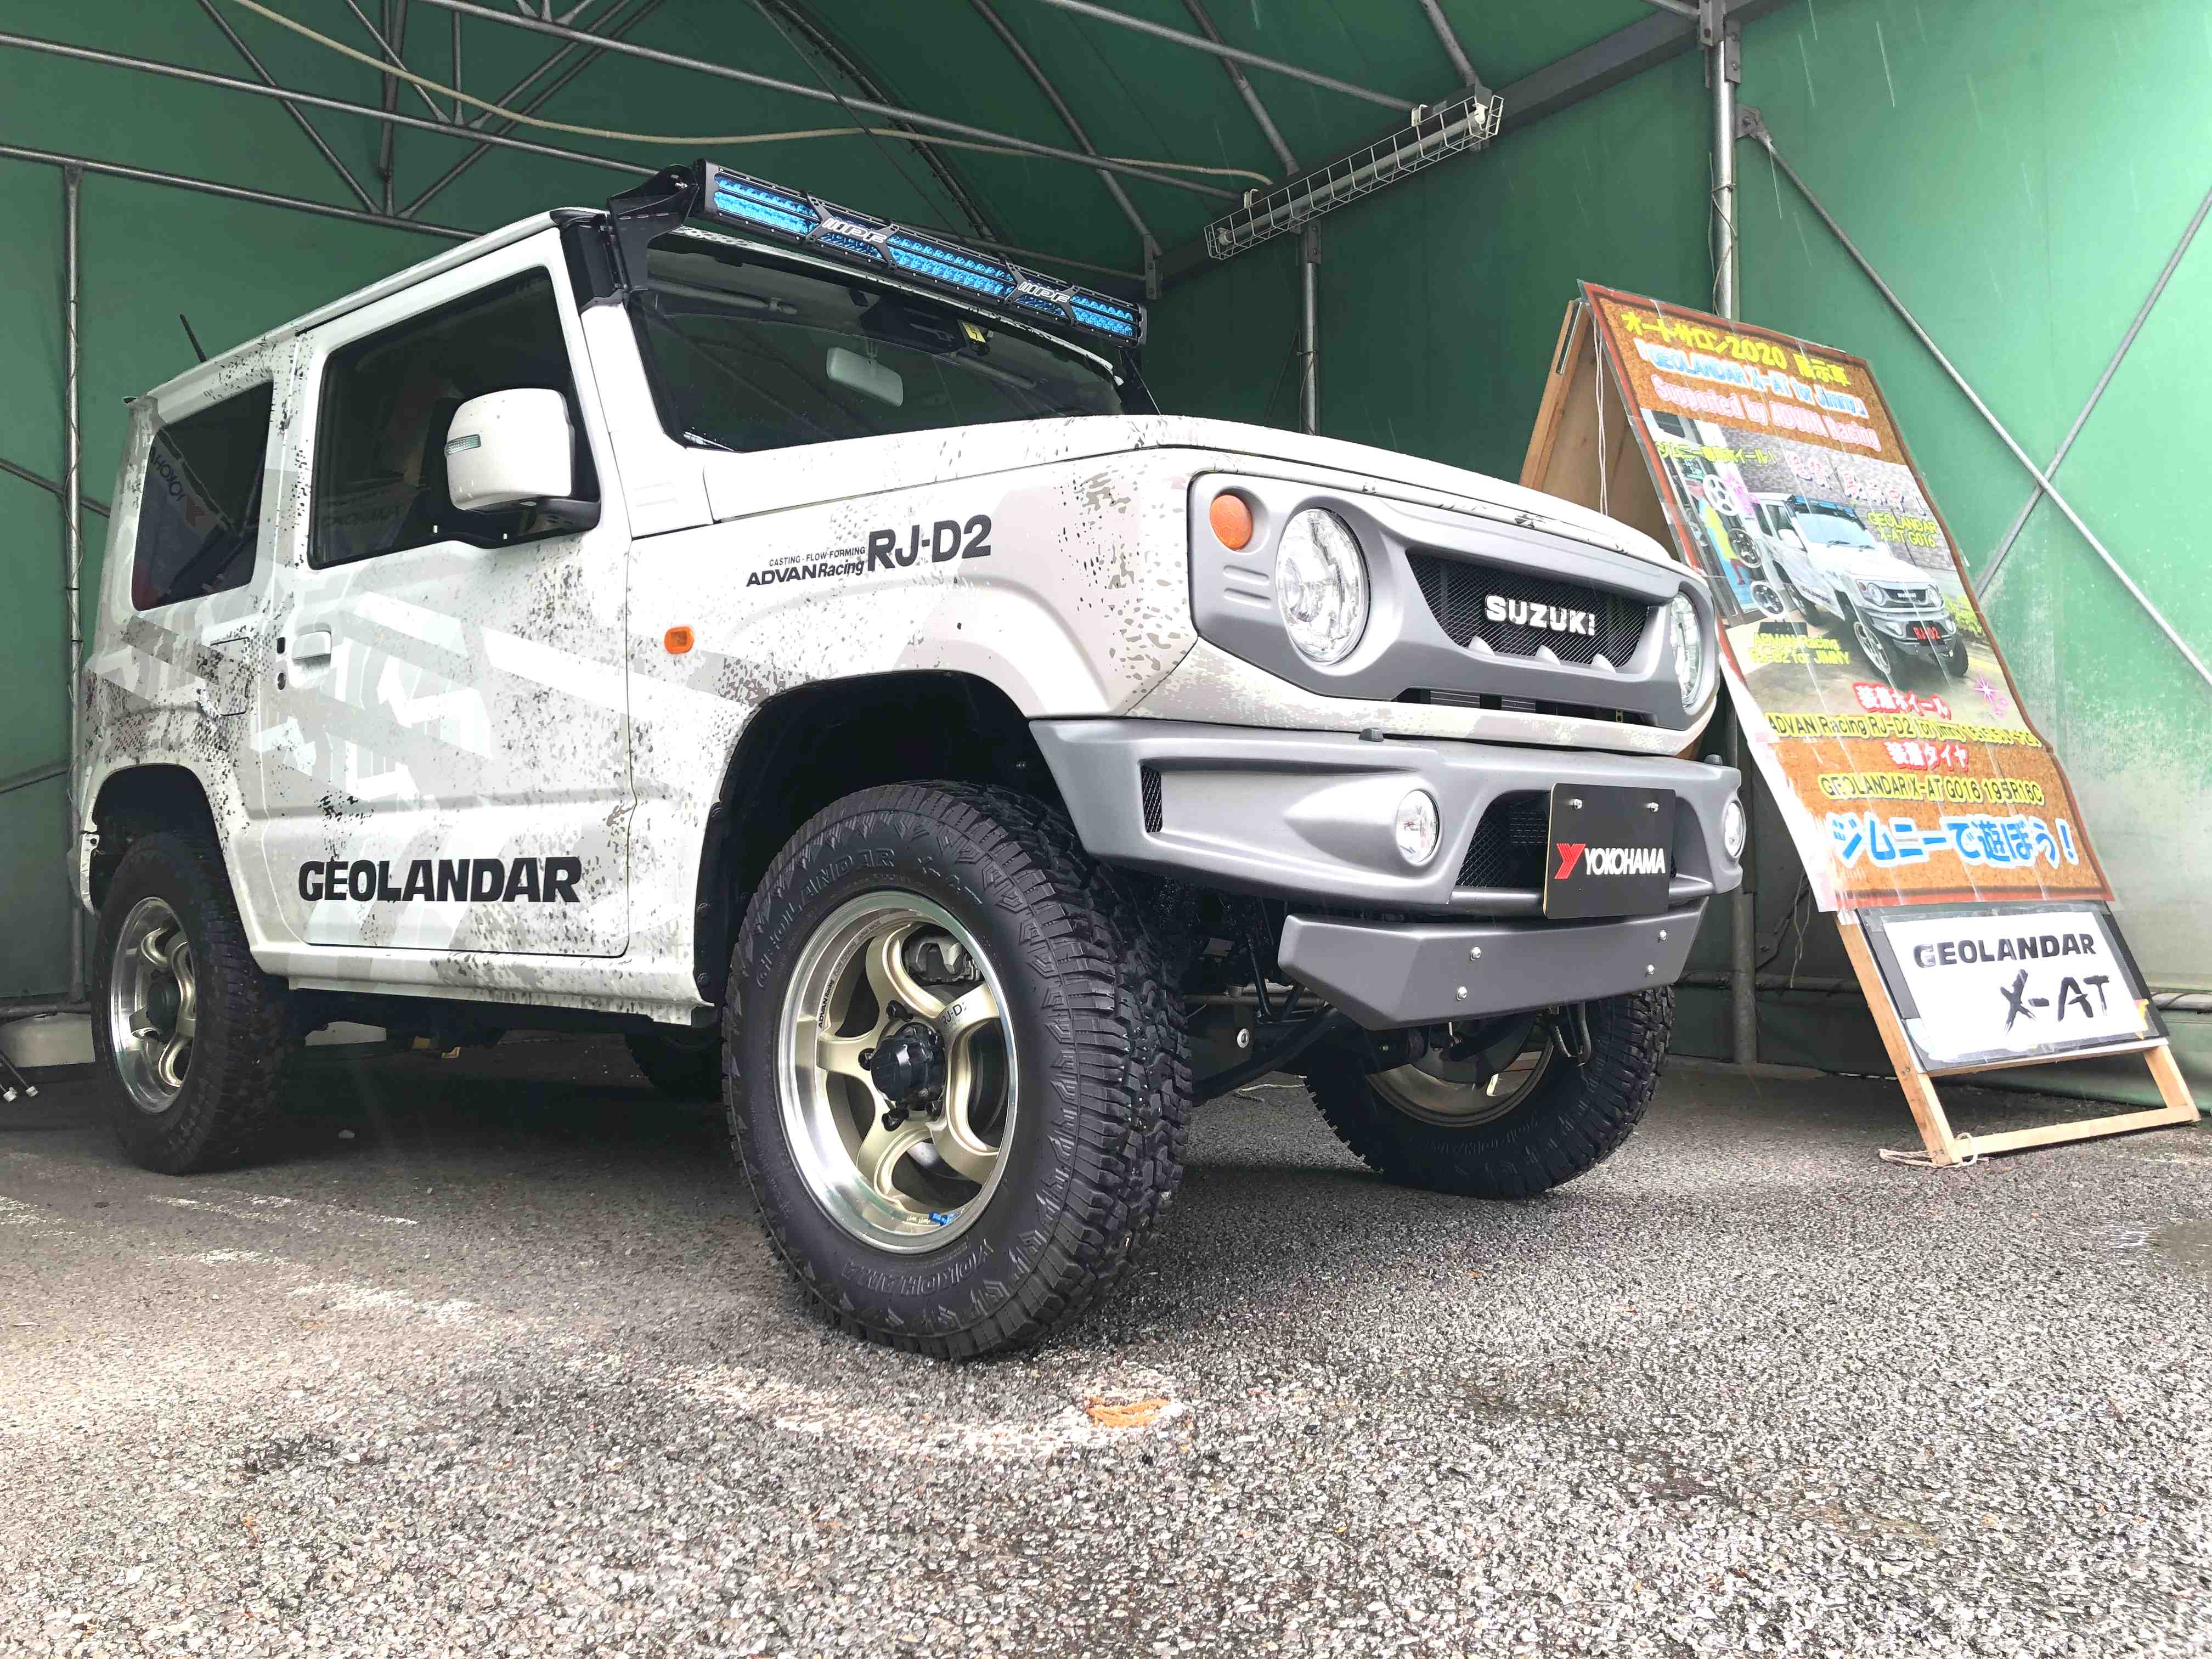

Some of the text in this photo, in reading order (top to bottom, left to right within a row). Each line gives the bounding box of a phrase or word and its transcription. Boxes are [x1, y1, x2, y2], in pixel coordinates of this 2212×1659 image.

[1621, 312, 1787, 369] オートサロン2020
[1867, 512, 1938, 534] GEOLANDAR
[1876, 526, 1906, 543] X-AT
[769, 555, 800, 567] CASTING
[867, 514, 991, 572] RJ-D2
[1485, 594, 1595, 636] SUZUKI
[1767, 714, 1818, 734] ADVAN
[1818, 715, 1867, 736] Racing
[1868, 715, 1914, 735] RJ-D2
[1909, 775, 1942, 798] X-AT
[1983, 781, 2042, 802] 195R16C
[1831, 816, 2076, 865] ジムニーで遊ぼう！
[298, 856, 582, 902] GEOLANDAR
[1584, 848, 1666, 875] YOKOHAMA
[1913, 934, 2096, 968] GEOLANDAR
[2000, 969, 2110, 1035] X-AT
